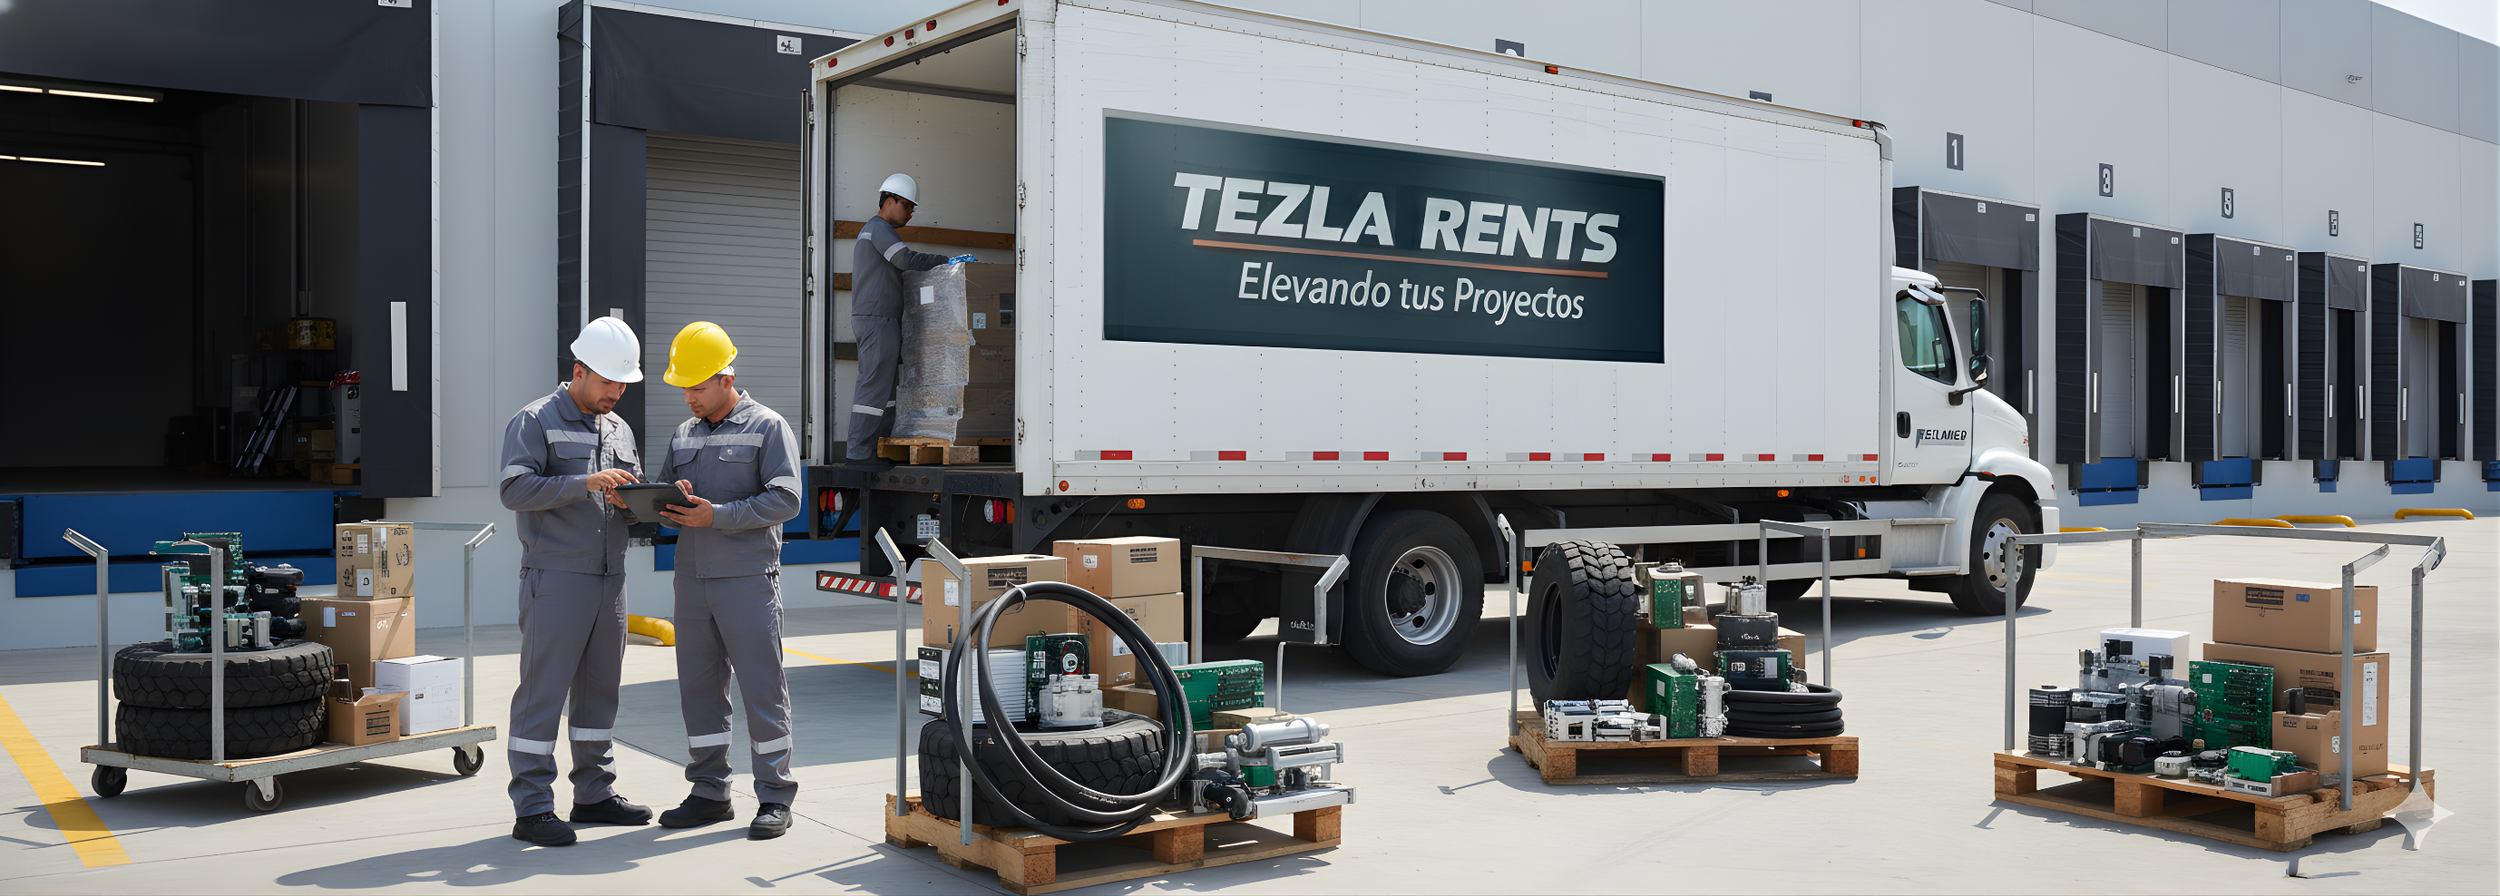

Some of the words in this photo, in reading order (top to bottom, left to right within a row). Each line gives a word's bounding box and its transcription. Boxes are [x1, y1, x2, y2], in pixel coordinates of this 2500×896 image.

[1951, 138, 1958, 167] 1
[2102, 167, 2111, 194] 3
[1173, 171, 1395, 247] TEZLA
[1419, 196, 1620, 264] RENTS
[1237, 261, 1391, 308] Elevando
[1399, 277, 1445, 312] tus
[1452, 277, 1585, 326] Proyectos
